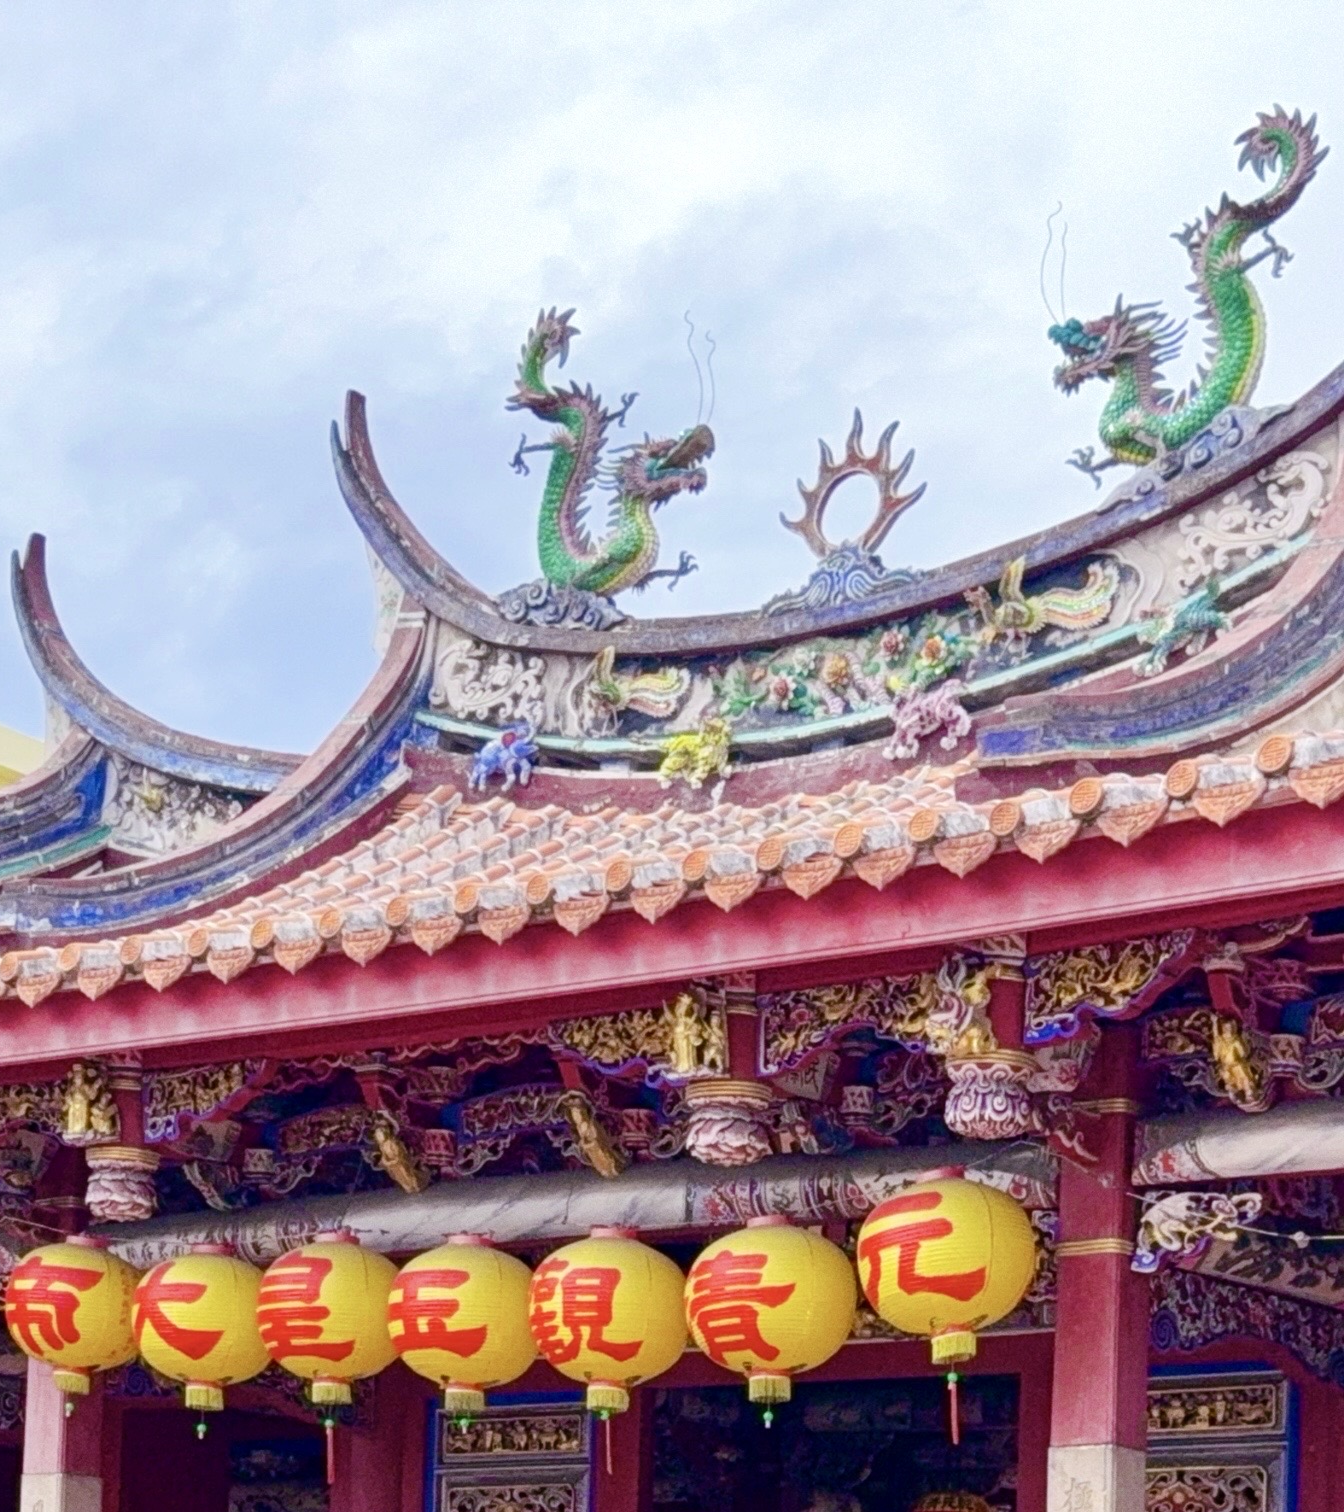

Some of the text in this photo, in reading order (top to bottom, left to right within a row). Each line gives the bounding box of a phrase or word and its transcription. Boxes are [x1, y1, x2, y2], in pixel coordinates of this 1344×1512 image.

[859, 1191, 988, 1307] 元
[132, 1260, 227, 1361] 大
[256, 1250, 356, 1362] 皇
[387, 1268, 488, 1359] 玉
